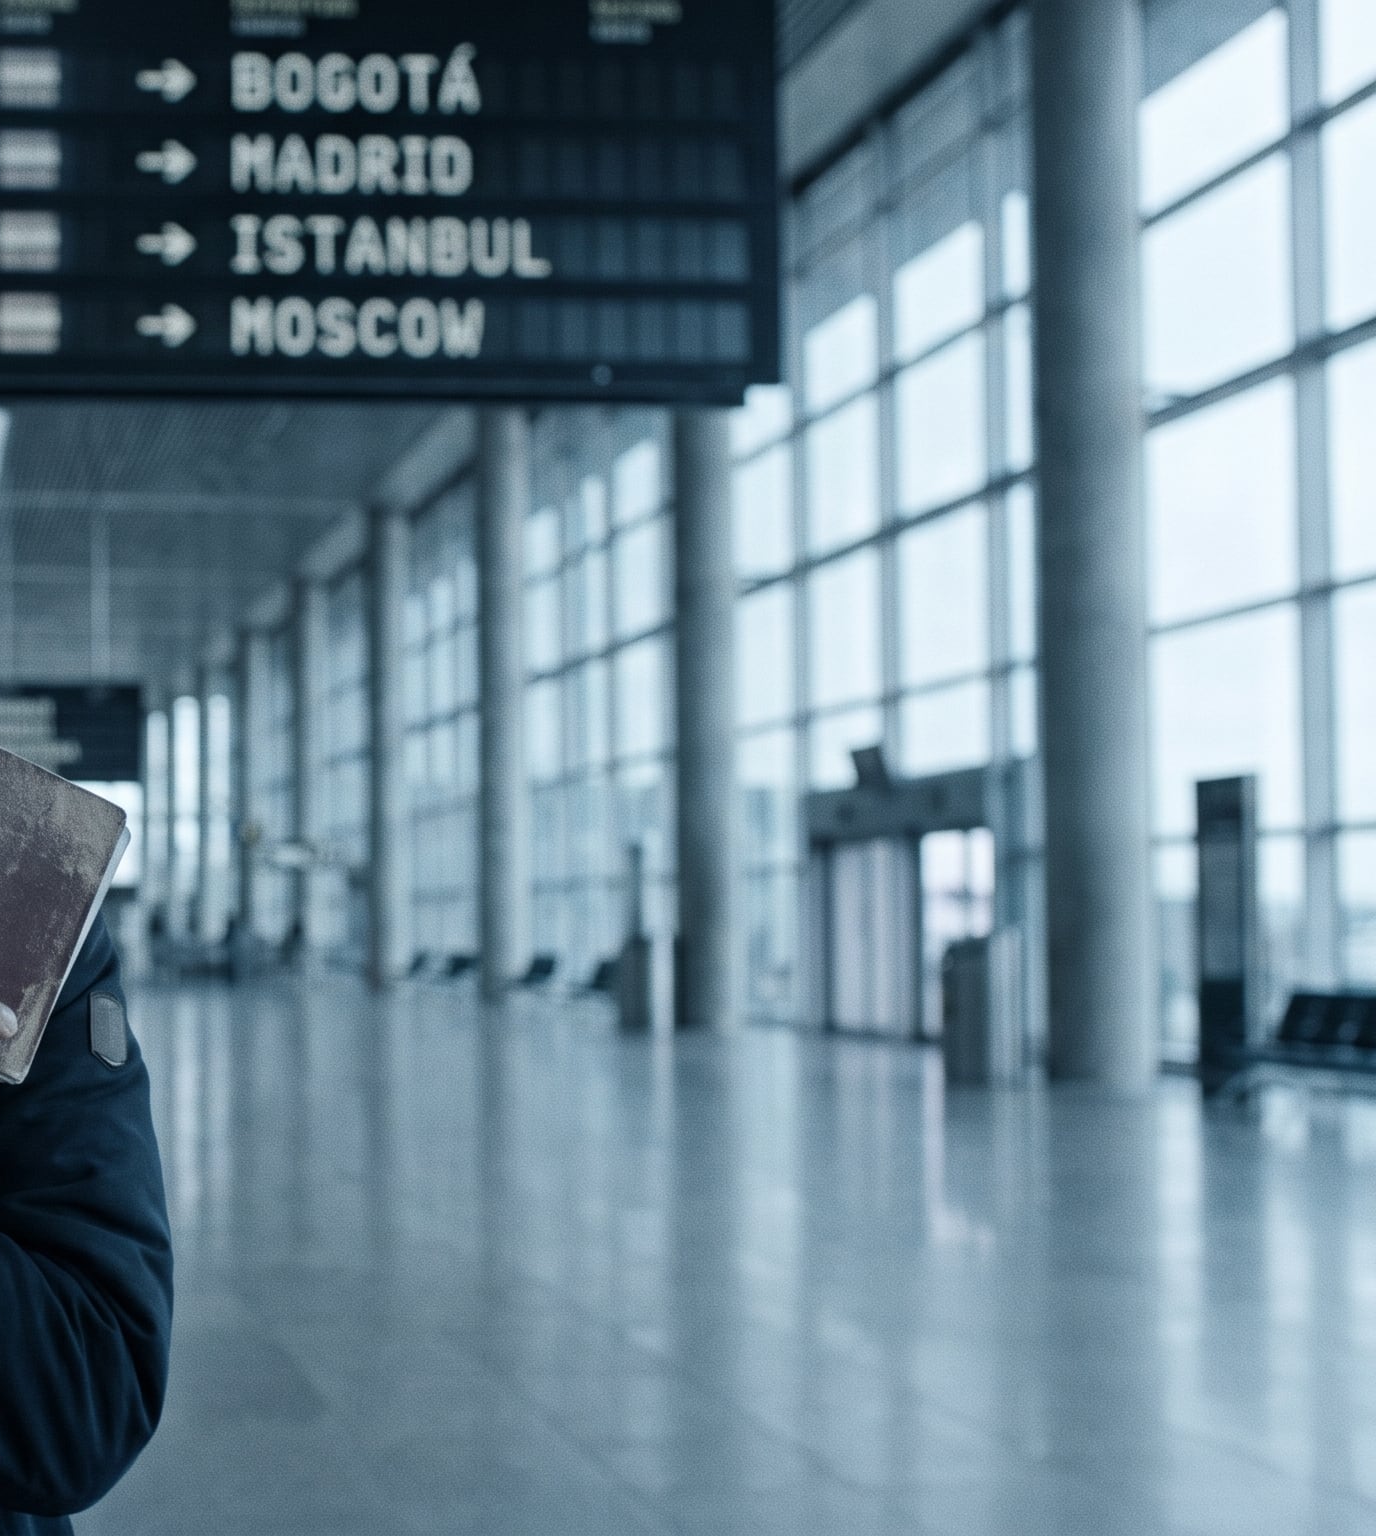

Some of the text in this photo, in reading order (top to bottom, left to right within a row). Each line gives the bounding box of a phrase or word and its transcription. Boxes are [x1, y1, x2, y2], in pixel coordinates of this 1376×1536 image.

[231, 43, 481, 113] BOGOTÁ
[230, 133, 474, 196] MADRID
[230, 213, 553, 279] ISTANBUL
[230, 295, 486, 359] MOSCOW
